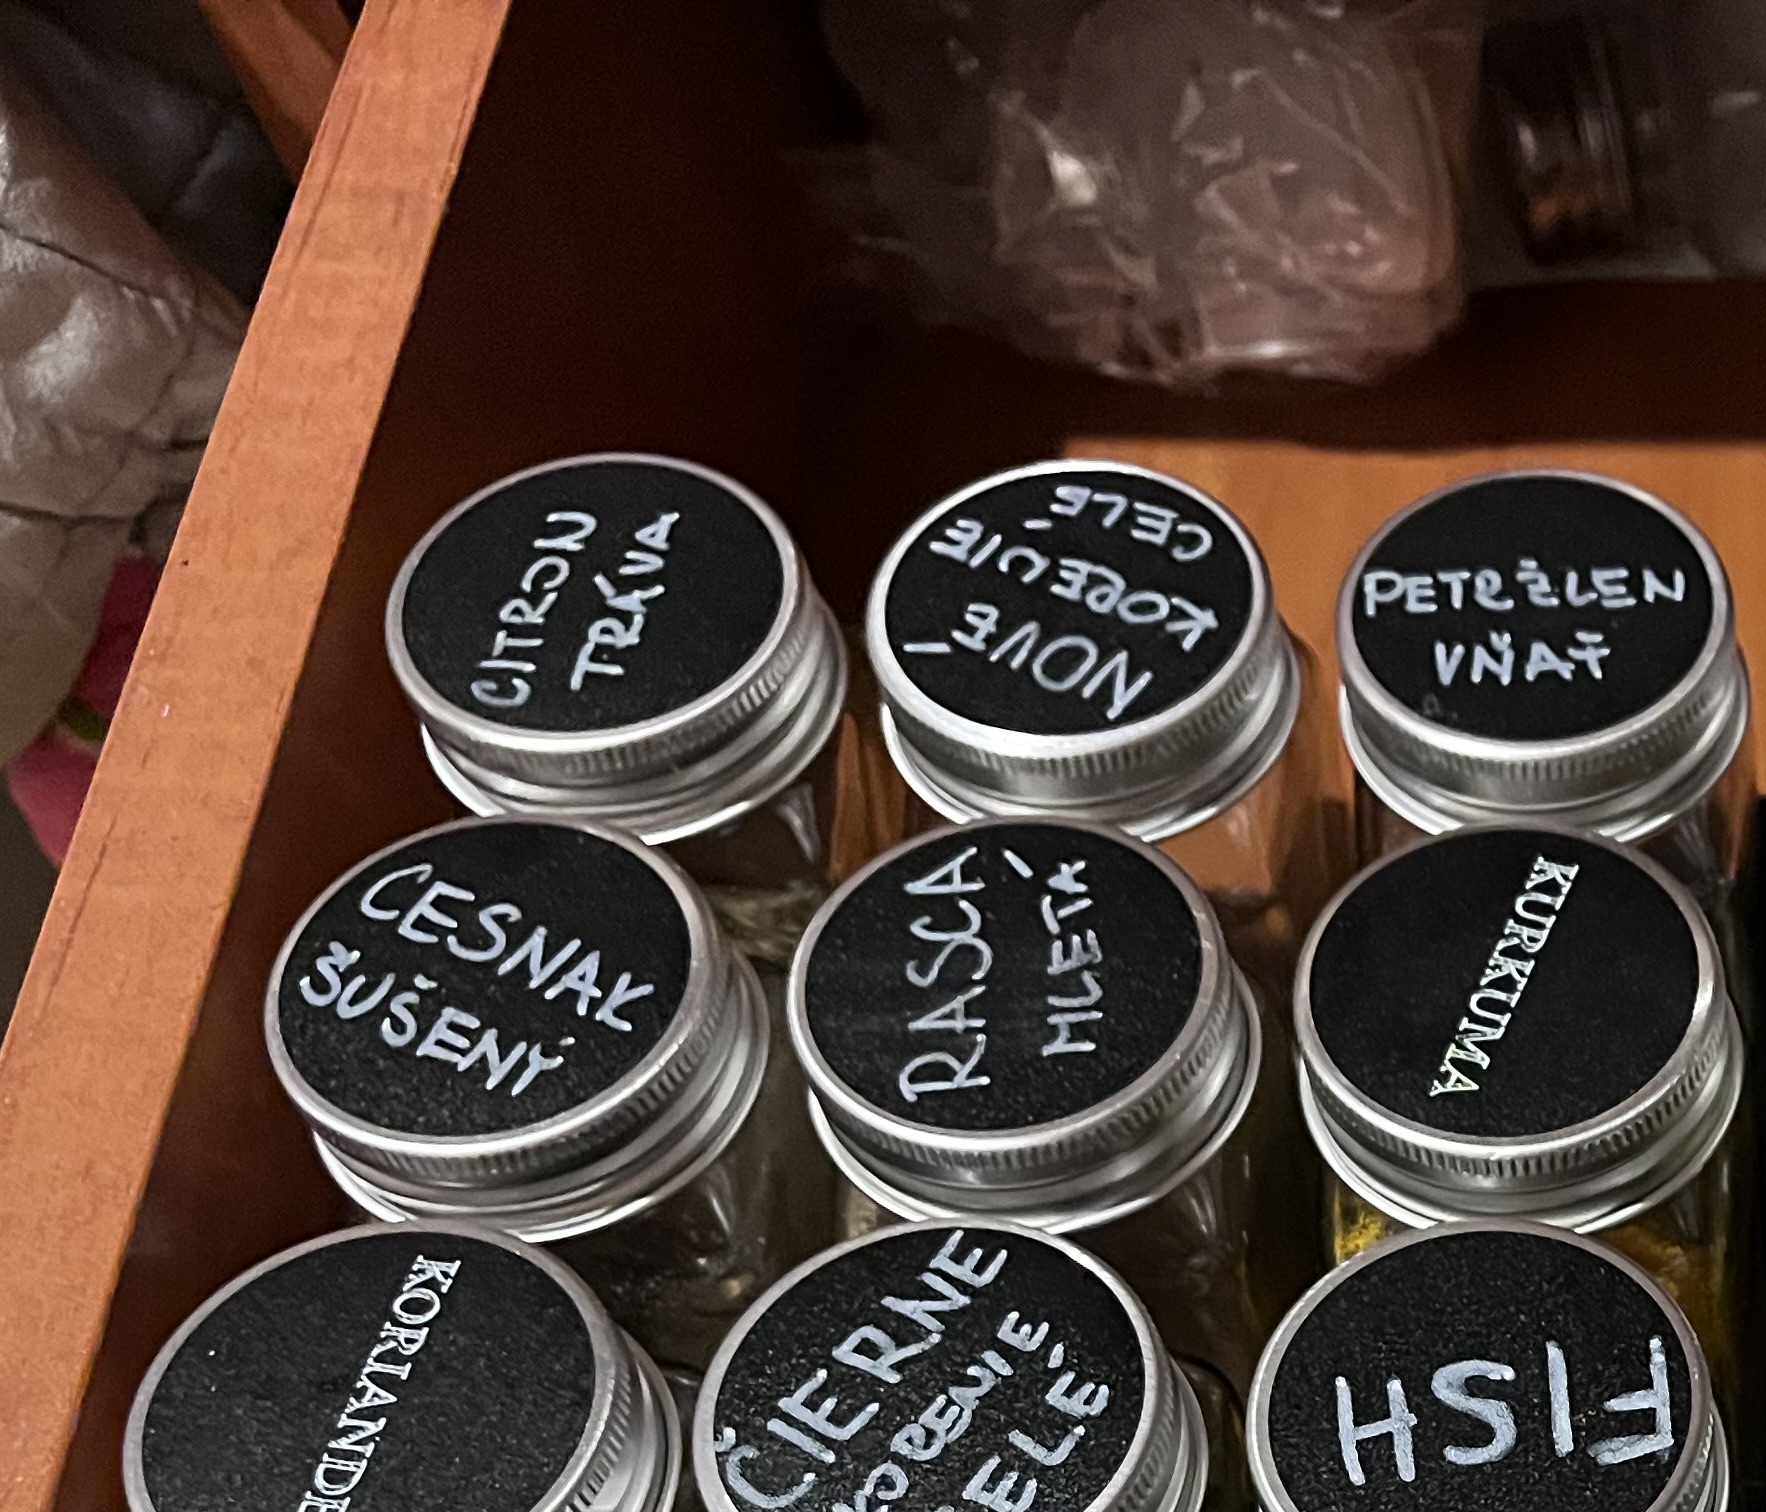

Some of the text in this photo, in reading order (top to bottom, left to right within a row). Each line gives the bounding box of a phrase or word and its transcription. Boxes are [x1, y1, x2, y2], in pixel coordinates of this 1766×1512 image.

[472, 510, 597, 708] CITRON
[570, 510, 679, 692] TRÁVA
[930, 517, 1219, 653] KORENIE
[1026, 483, 1213, 562] CELÉ
[1363, 557, 1686, 617] PETRŽLEN
[903, 601, 1154, 721] NOVÉ
[360, 864, 654, 1031] CESNAK
[898, 846, 992, 1102] RASCA
[1005, 848, 1103, 1056] MLETÁ
[1427, 853, 1580, 1098] KURKUMA
[712, 1228, 1007, 1509] ČIERNE
[1334, 1336, 1674, 1486] FISH
